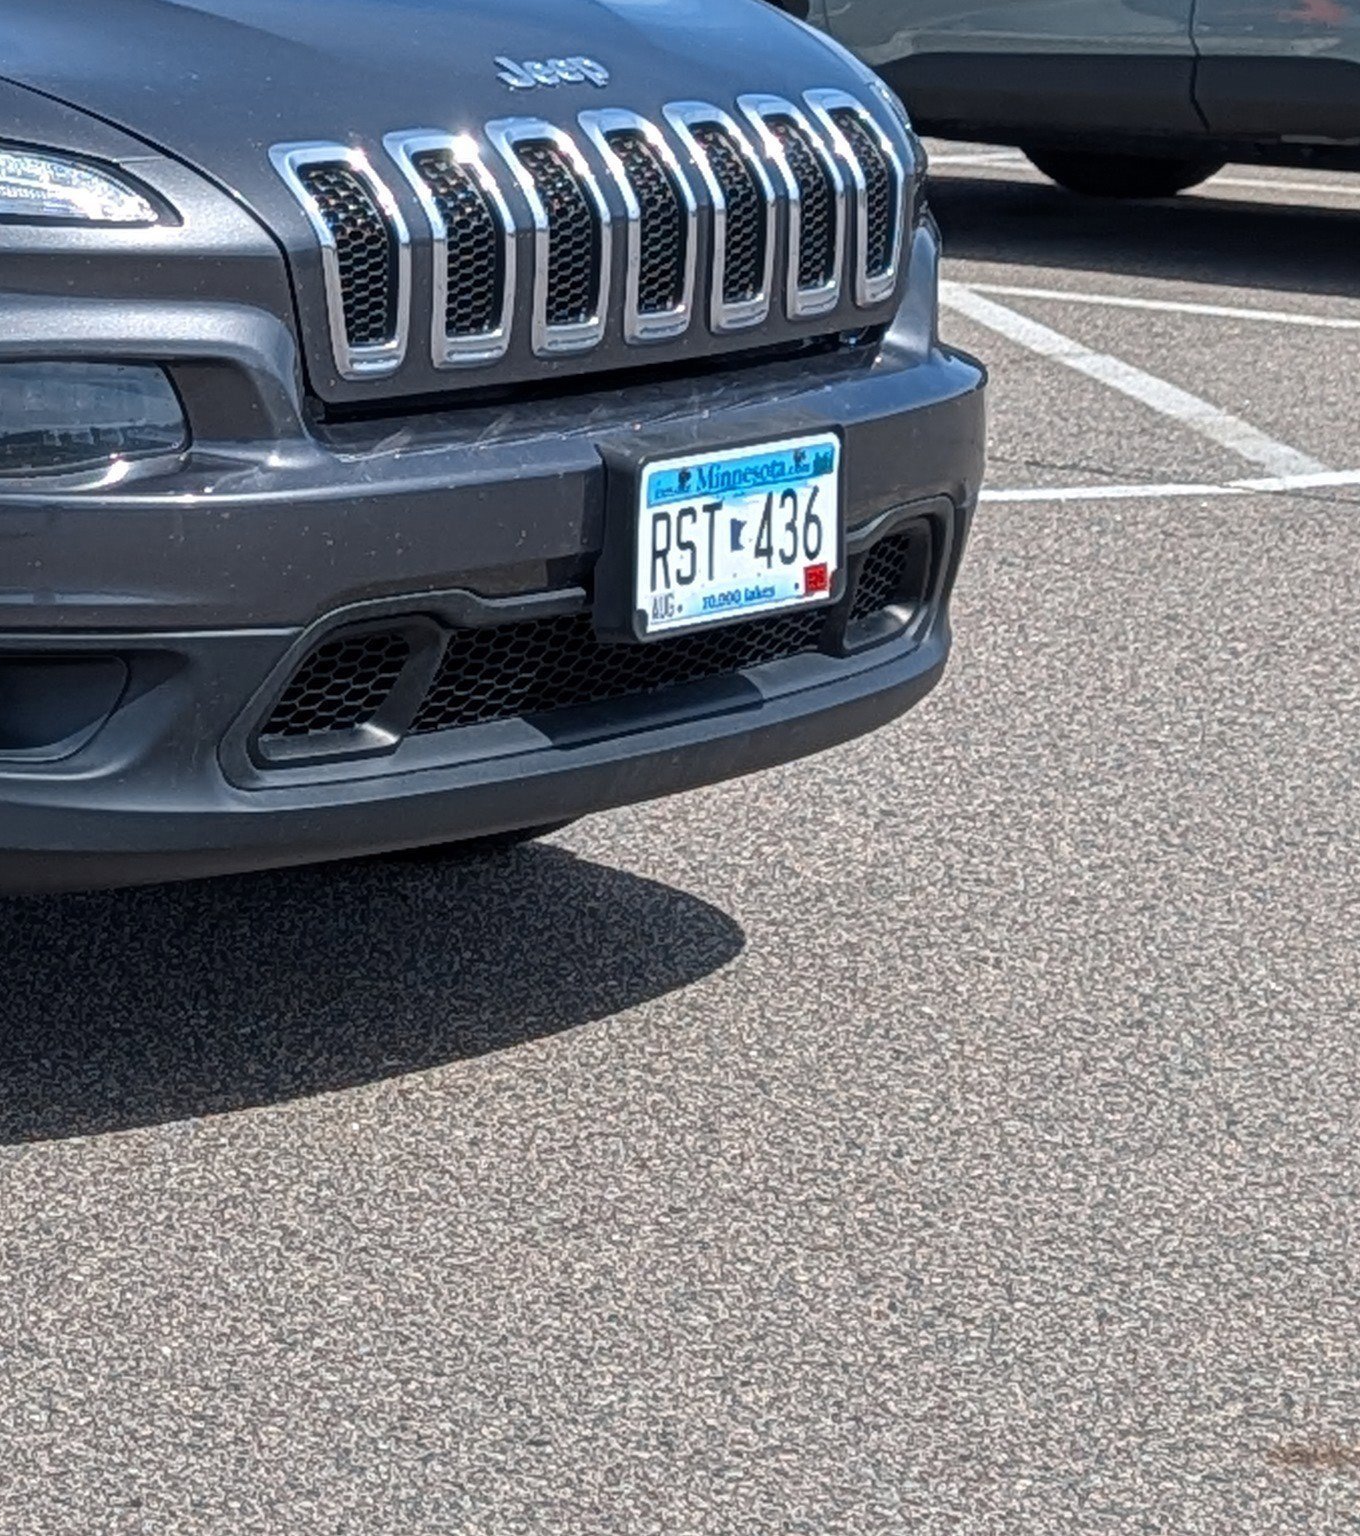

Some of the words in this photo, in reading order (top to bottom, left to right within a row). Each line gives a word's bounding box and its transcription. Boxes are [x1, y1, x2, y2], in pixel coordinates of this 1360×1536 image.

[494, 56, 610, 88] Jeep
[650, 501, 723, 593] RST
[754, 485, 822, 569] 436
[651, 593, 675, 620] AUG
